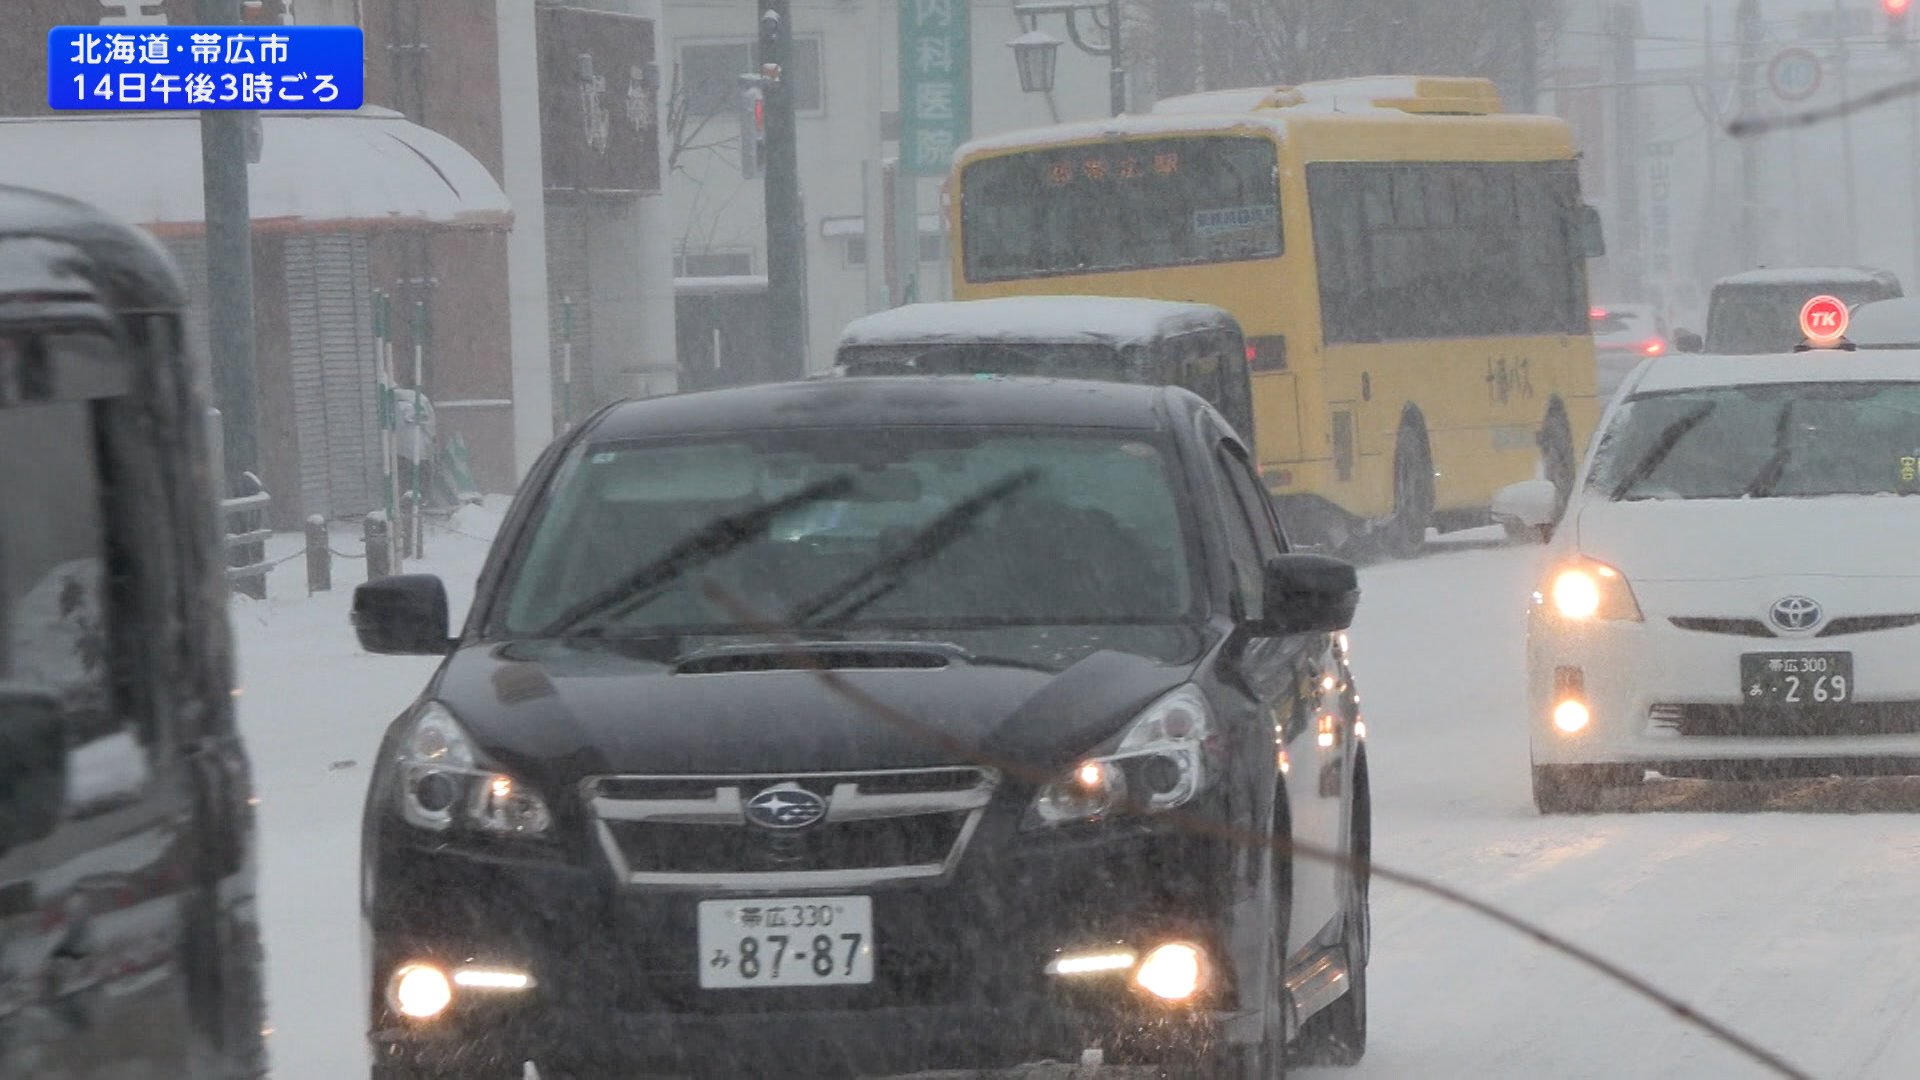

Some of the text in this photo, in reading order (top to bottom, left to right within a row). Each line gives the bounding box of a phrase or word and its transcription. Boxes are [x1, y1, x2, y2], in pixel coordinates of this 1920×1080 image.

[1810, 311, 1838, 327] TK
[710, 934, 862, 979] み 87-87
